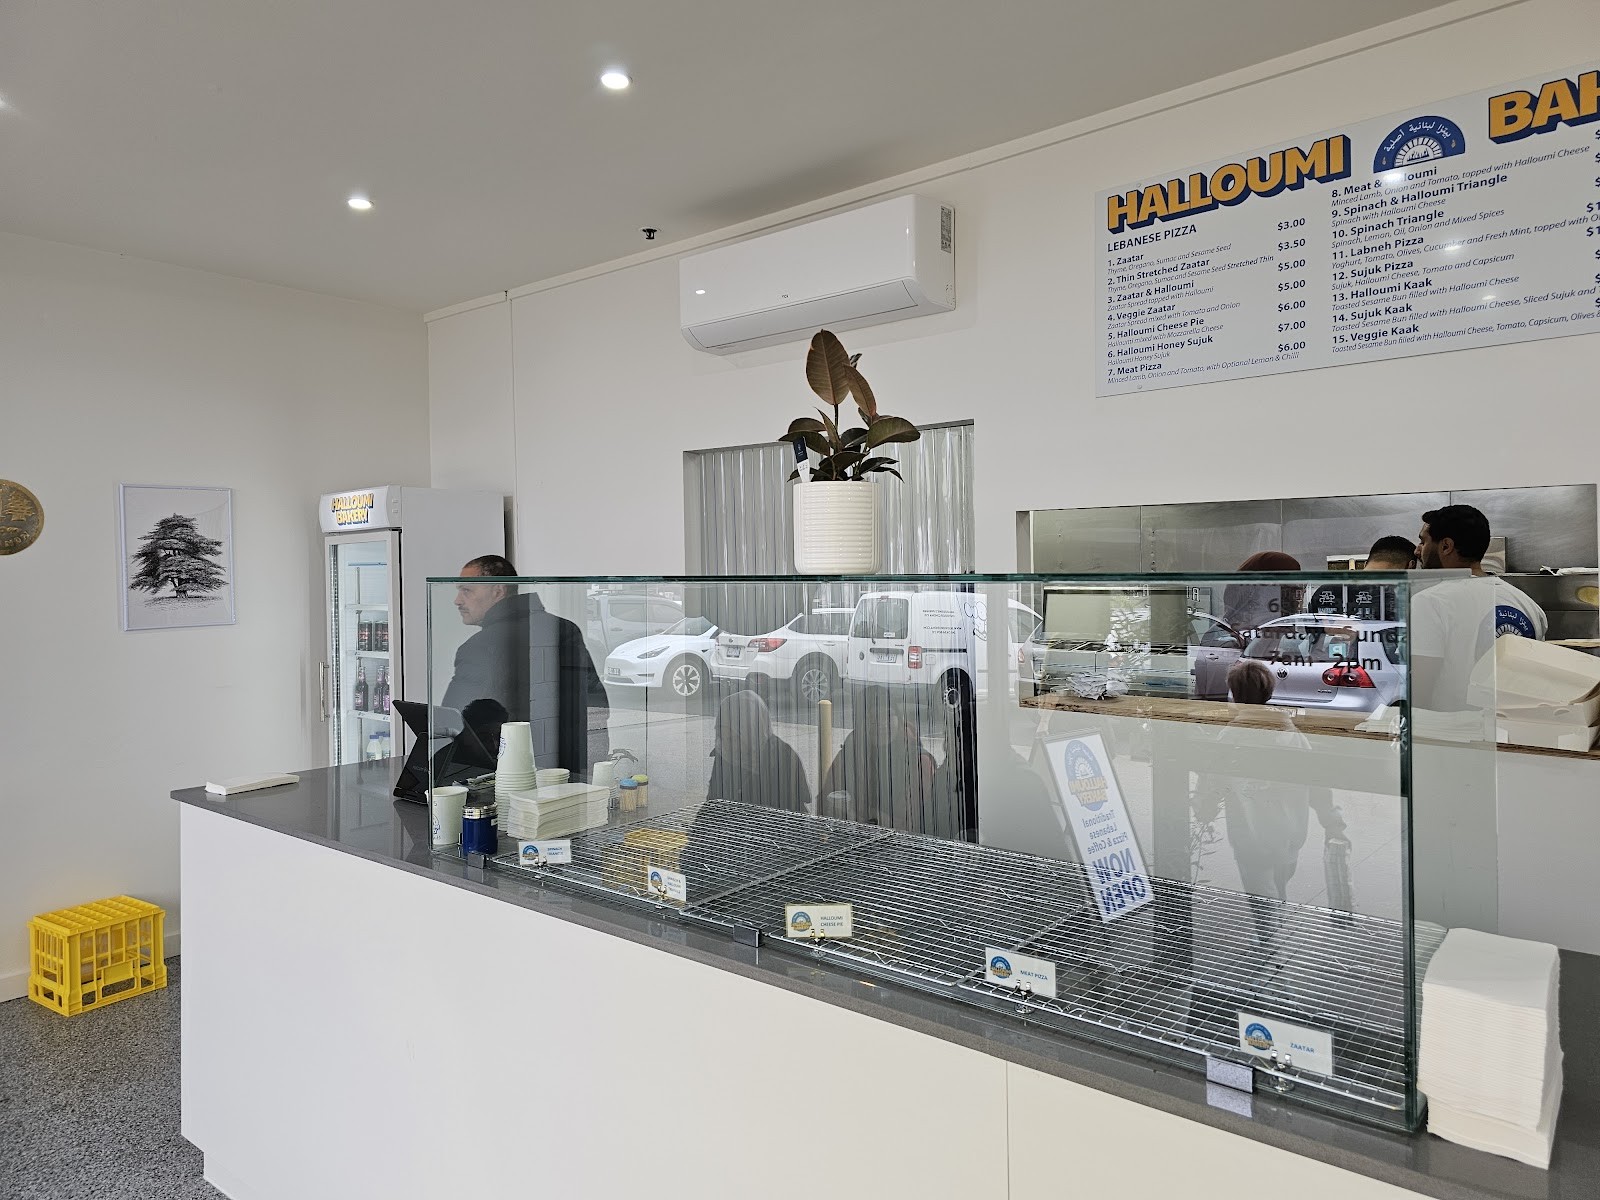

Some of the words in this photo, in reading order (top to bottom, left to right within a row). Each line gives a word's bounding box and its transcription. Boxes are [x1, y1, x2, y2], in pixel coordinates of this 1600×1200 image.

[1107, 134, 1351, 235] HALLOUMI
[1331, 194, 1359, 207] Minced
[1359, 187, 1385, 201] Lamb,
[1409, 179, 1426, 190] and
[1427, 174, 1460, 186] Tomato,
[1462, 164, 1492, 178] topped
[1493, 161, 1513, 171] with
[1514, 151, 1556, 167] Halloumi
[1557, 145, 1590, 158] Cheese
[1331, 189, 1341, 198] 8.
[1343, 182, 1371, 196] Meat
[1331, 209, 1341, 218] 9.
[1343, 198, 1387, 216] Spinach
[1390, 196, 1399, 208] &
[1401, 183, 1454, 204] Halloumi
[1456, 173, 1507, 191] Triangle
[1277, 217, 1305, 232] $3.00
[1331, 214, 1361, 228] Spinach
[1362, 211, 1379, 220] with
[1380, 202, 1416, 217] Halloumi
[1417, 198, 1446, 209] Cheese
[1332, 229, 1348, 239] 10.
[1350, 218, 1394, 236] Spinach
[1396, 209, 1444, 226] Triangle
[1107, 231, 1161, 253] LEBANESE
[1164, 224, 1197, 240] PIZZA
[1331, 235, 1362, 249] Spinach,
[1364, 231, 1392, 242] Lemon,
[1393, 227, 1406, 236] Oil,
[1407, 221, 1432, 233] Onion
[1433, 218, 1451, 228] and
[1451, 212, 1477, 225] Mixed
[1478, 209, 1504, 220] Spices
[1277, 238, 1306, 252] $3.50
[1331, 258, 1362, 270] Yoghurt,
[1364, 253, 1395, 263] Tomato,
[1396, 247, 1422, 257] Olives,
[1466, 234, 1484, 247] and
[1484, 230, 1508, 241] Fresh
[1509, 227, 1532, 236] Mint,
[1533, 219, 1567, 232] topped
[1568, 215, 1588, 226] with
[1332, 250, 1348, 260] 11.
[1350, 241, 1391, 257] Labneh
[1394, 236, 1424, 248] Pizza
[1107, 259, 1115, 267] 1.
[1116, 253, 1144, 266] Zaatar
[1277, 258, 1306, 272] $5.00
[1331, 280, 1353, 290] Sujuk,
[1354, 273, 1390, 286] Halloumi
[1390, 270, 1420, 280] Cheese,
[1422, 264, 1453, 274] Tomato
[1454, 259, 1472, 269] and
[1472, 253, 1514, 266] Capsicum
[1332, 271, 1348, 281] 12.
[1350, 264, 1382, 278] Sujuk
[1384, 260, 1413, 272] Pizza
[1107, 277, 1115, 286] 2.
[1116, 273, 1135, 284] Thin
[1136, 263, 1178, 280] Stretched
[1180, 259, 1210, 271] Zaatar
[1107, 296, 1115, 304] 3.
[1116, 291, 1144, 302] Zaatar
[1145, 288, 1152, 296] &
[1154, 279, 1194, 295] Halloumi
[1277, 279, 1306, 292] $5.00
[1331, 299, 1360, 311] Toasted
[1361, 296, 1390, 306] Sesame
[1391, 294, 1407, 302] Bun
[1408, 288, 1428, 299] filled
[1429, 286, 1447, 295] with
[1448, 279, 1488, 292] Halloumi
[1488, 276, 1519, 286] Cheese
[1332, 292, 1348, 302] 13.
[1350, 282, 1401, 299] Halloumi
[1403, 277, 1432, 290] Kaak
[1116, 308, 1145, 320] Veggie
[1147, 304, 1176, 315] Zaatar
[1277, 299, 1306, 312] $6.00
[1331, 321, 1360, 332] Toasted
[1361, 318, 1390, 328] Sesame
[1391, 315, 1407, 323] Bun
[1408, 310, 1428, 320] filled
[1429, 308, 1448, 317] with
[1448, 301, 1489, 314] Halloumi
[1488, 299, 1521, 309] Cheese,
[1523, 292, 1549, 304] Sliced
[1550, 289, 1576, 300] Sujuk
[1577, 286, 1596, 296] and
[1332, 313, 1348, 323] 14.
[1350, 307, 1382, 321] Sujuk
[1384, 302, 1413, 315] Kaak
[1107, 332, 1115, 340] 5.
[1117, 324, 1155, 338] Halloumi
[1156, 321, 1188, 332] Cheese
[1190, 317, 1204, 326] Pie
[1277, 320, 1306, 333] $7.00
[1332, 343, 1357, 353] Toasted
[1357, 339, 1383, 350] Sesame
[1383, 338, 1397, 346] Bun
[1398, 334, 1416, 344] filled
[1416, 332, 1432, 342] with
[1432, 327, 1466, 339] Halloumi
[1466, 325, 1494, 334] Cheese,
[1496, 321, 1527, 330] Tomato,
[1528, 316, 1568, 327] Capsicum,
[1570, 312, 1595, 320] Olives
[1332, 334, 1348, 344] 15.
[1350, 328, 1388, 342] Veggie
[1391, 323, 1419, 336] Kaak
[1107, 350, 1115, 358] 6.
[1117, 343, 1155, 357] Halloumi
[1156, 340, 1185, 350] Honey
[1187, 334, 1213, 346] Sujuk
[1277, 340, 1306, 353] $6.00
[1107, 368, 1115, 376] 7.
[1117, 365, 1138, 375] Meat
[1139, 363, 1162, 372] Pizza
[332, 493, 373, 512] HALLOUMI
[1290, 1042, 1315, 1053] ZAATAR
